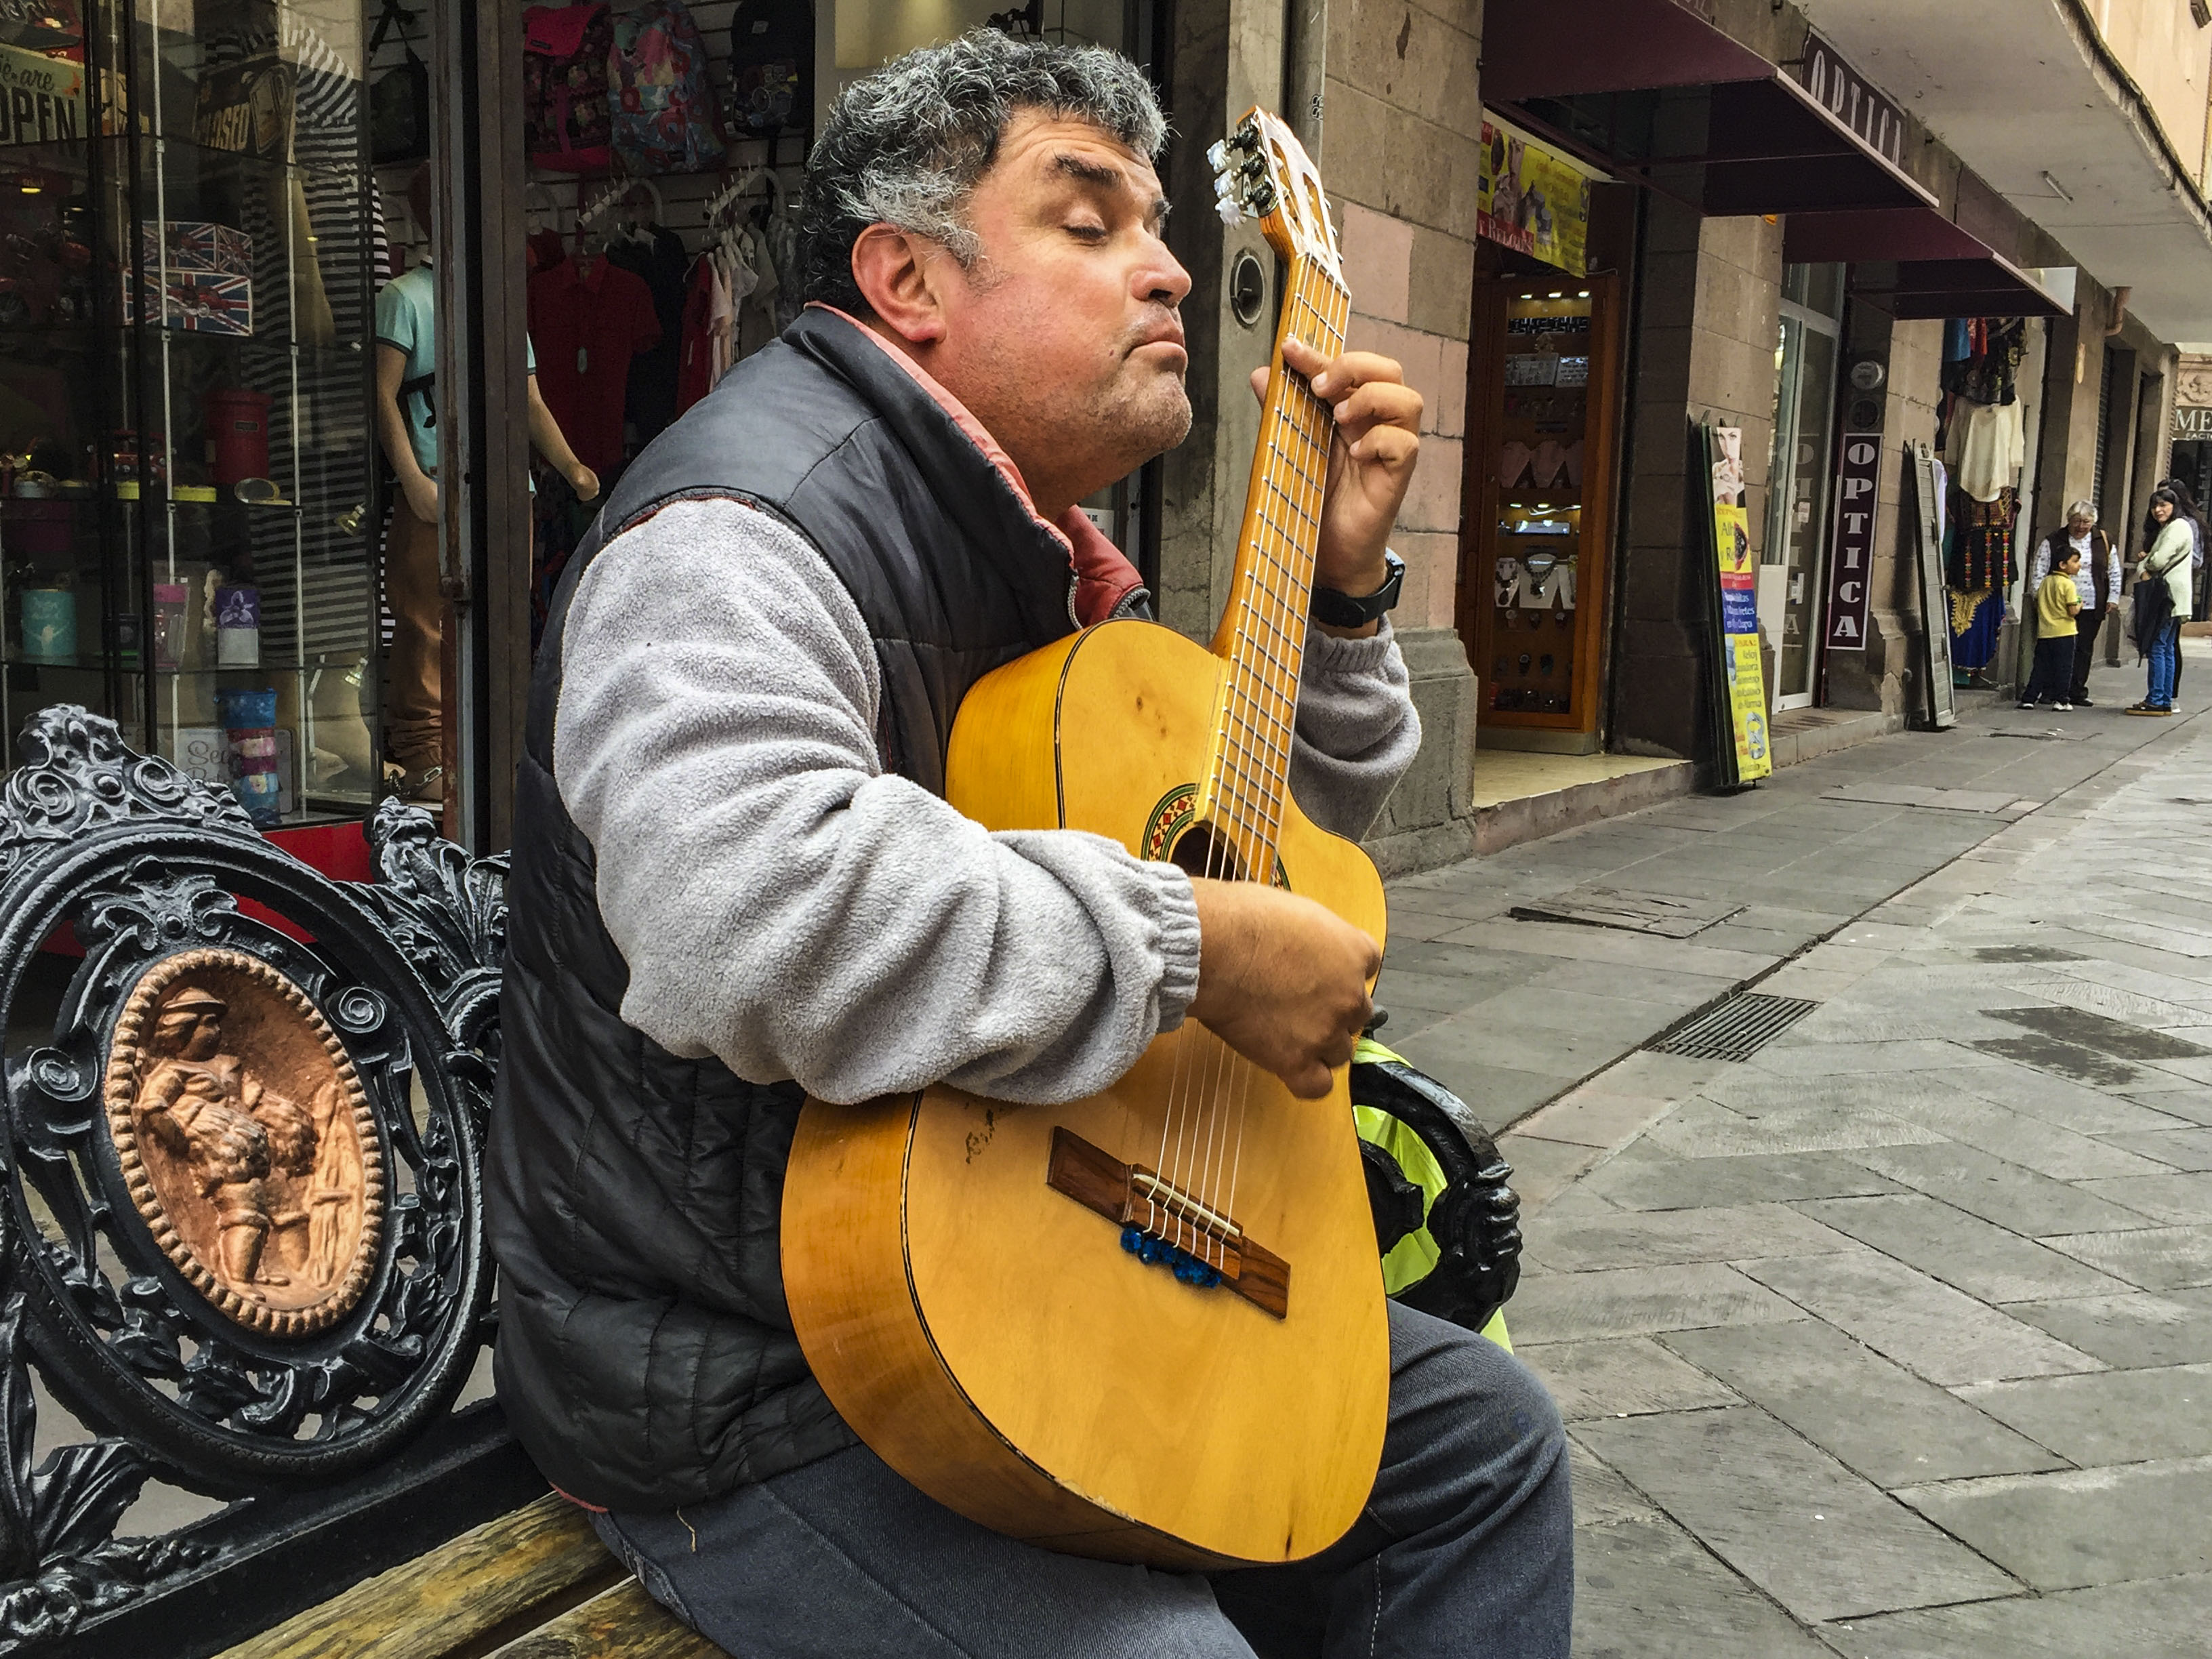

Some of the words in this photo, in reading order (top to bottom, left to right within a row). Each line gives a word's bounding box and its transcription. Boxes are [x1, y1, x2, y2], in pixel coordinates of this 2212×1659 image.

[20, 69, 54, 91] are
[1810, 49, 1902, 168] OPTICA
[2174, 409, 2212, 431] ME
[1832, 443, 1876, 638] OPTICA
